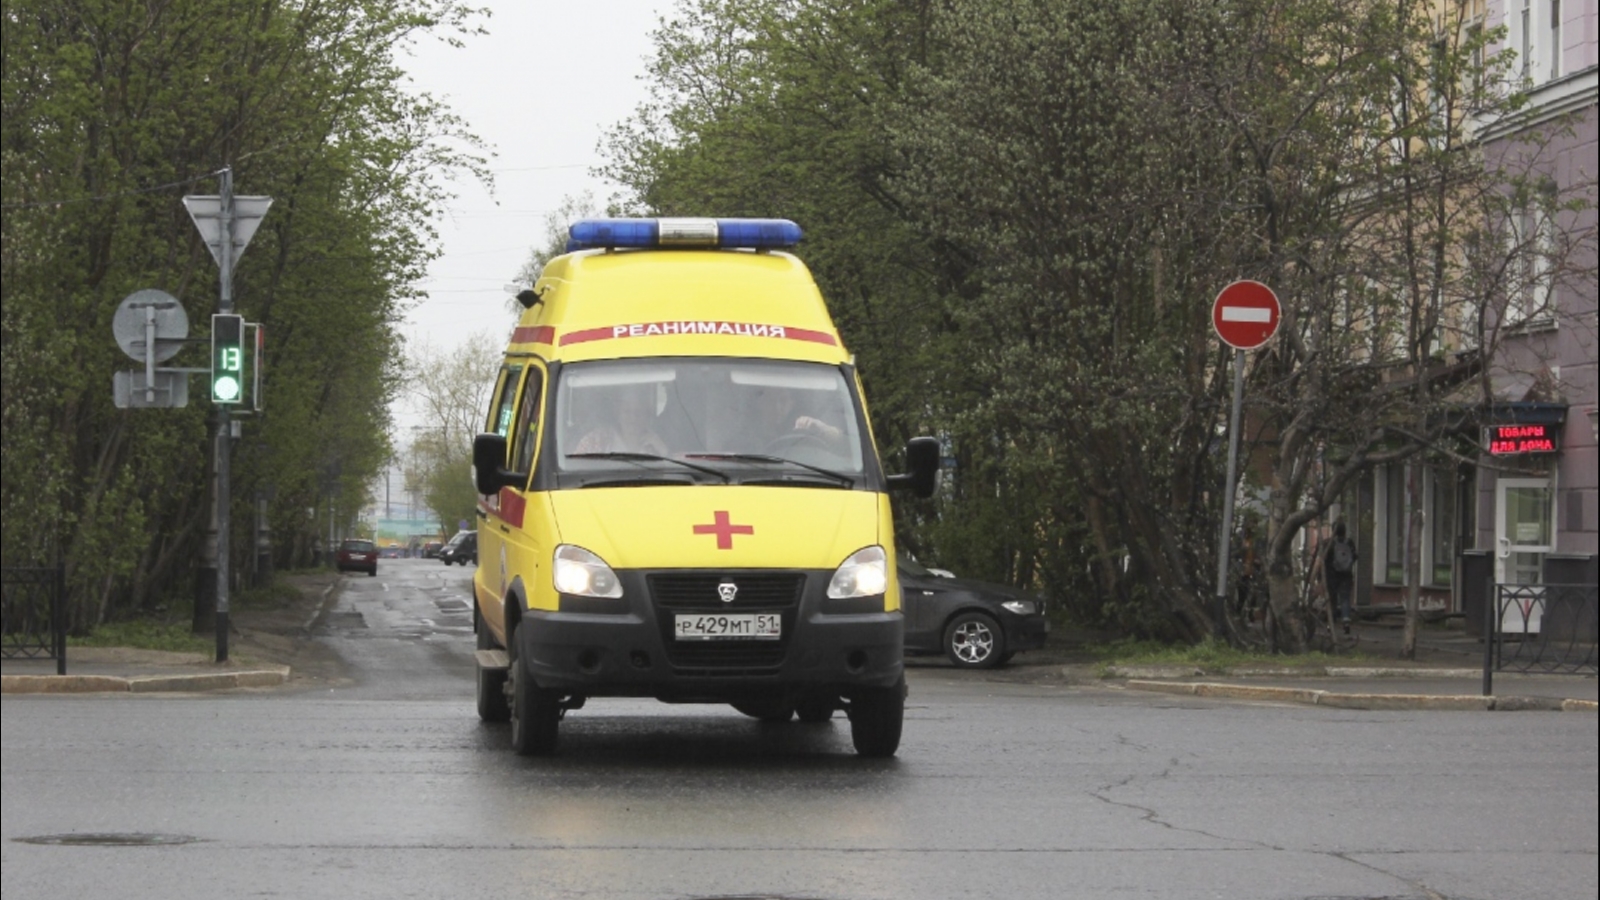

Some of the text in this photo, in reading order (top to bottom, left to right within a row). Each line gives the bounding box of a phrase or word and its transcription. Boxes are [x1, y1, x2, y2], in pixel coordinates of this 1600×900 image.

[612, 321, 786, 338] РЕАНИМАЦИЯ
[222, 347, 240, 371] 13
[1498, 426, 1544, 437] ТОВАРЫ
[1490, 441, 1516, 454] ДЛЯ
[757, 615, 775, 629] 51
